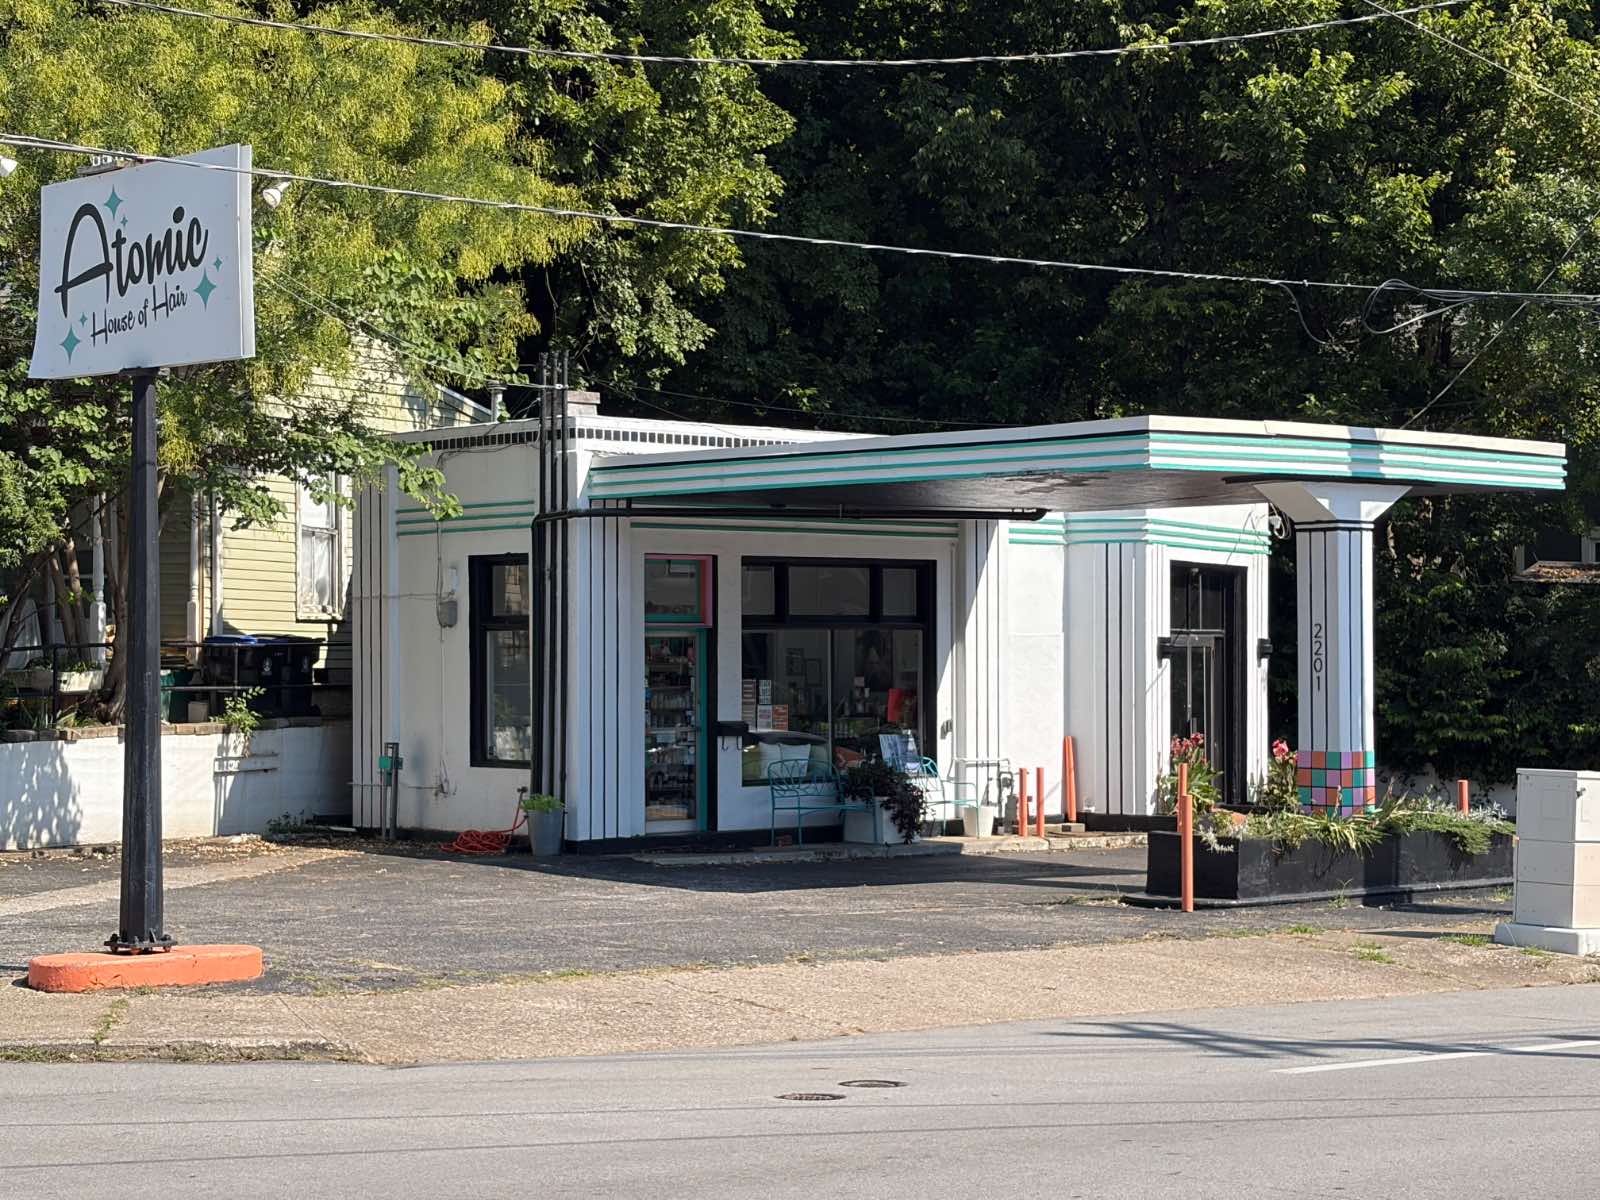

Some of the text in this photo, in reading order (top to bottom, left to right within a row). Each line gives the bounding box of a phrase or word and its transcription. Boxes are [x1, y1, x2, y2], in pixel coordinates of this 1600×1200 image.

[54, 203, 208, 318] Atomic
[90, 281, 188, 347] House of Hair
[1313, 623, 1323, 692] 2201
